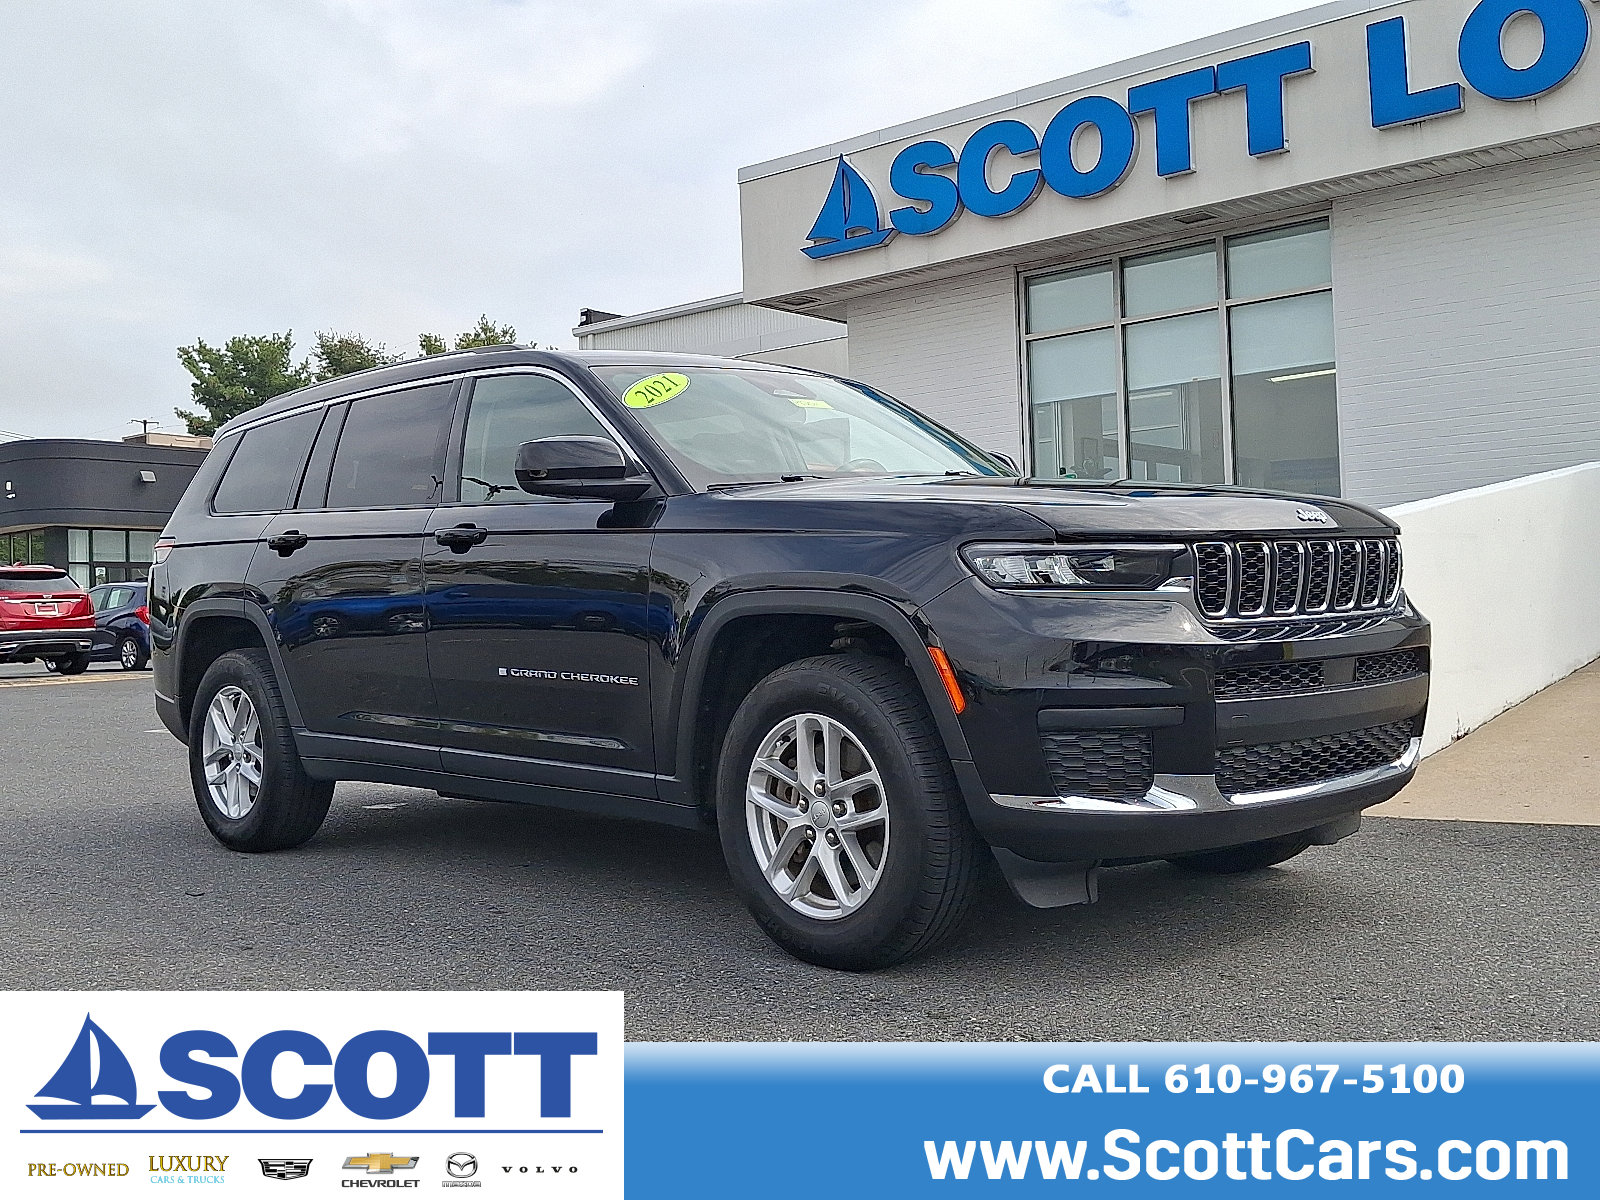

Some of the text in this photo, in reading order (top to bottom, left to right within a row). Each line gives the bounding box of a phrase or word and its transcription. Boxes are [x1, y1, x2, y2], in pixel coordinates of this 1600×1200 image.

[888, 0, 1589, 236] SCOTT LO
[635, 375, 679, 404] 2021
[1296, 508, 1327, 524] Jeep
[510, 668, 639, 686] GRAND CHEROKEE
